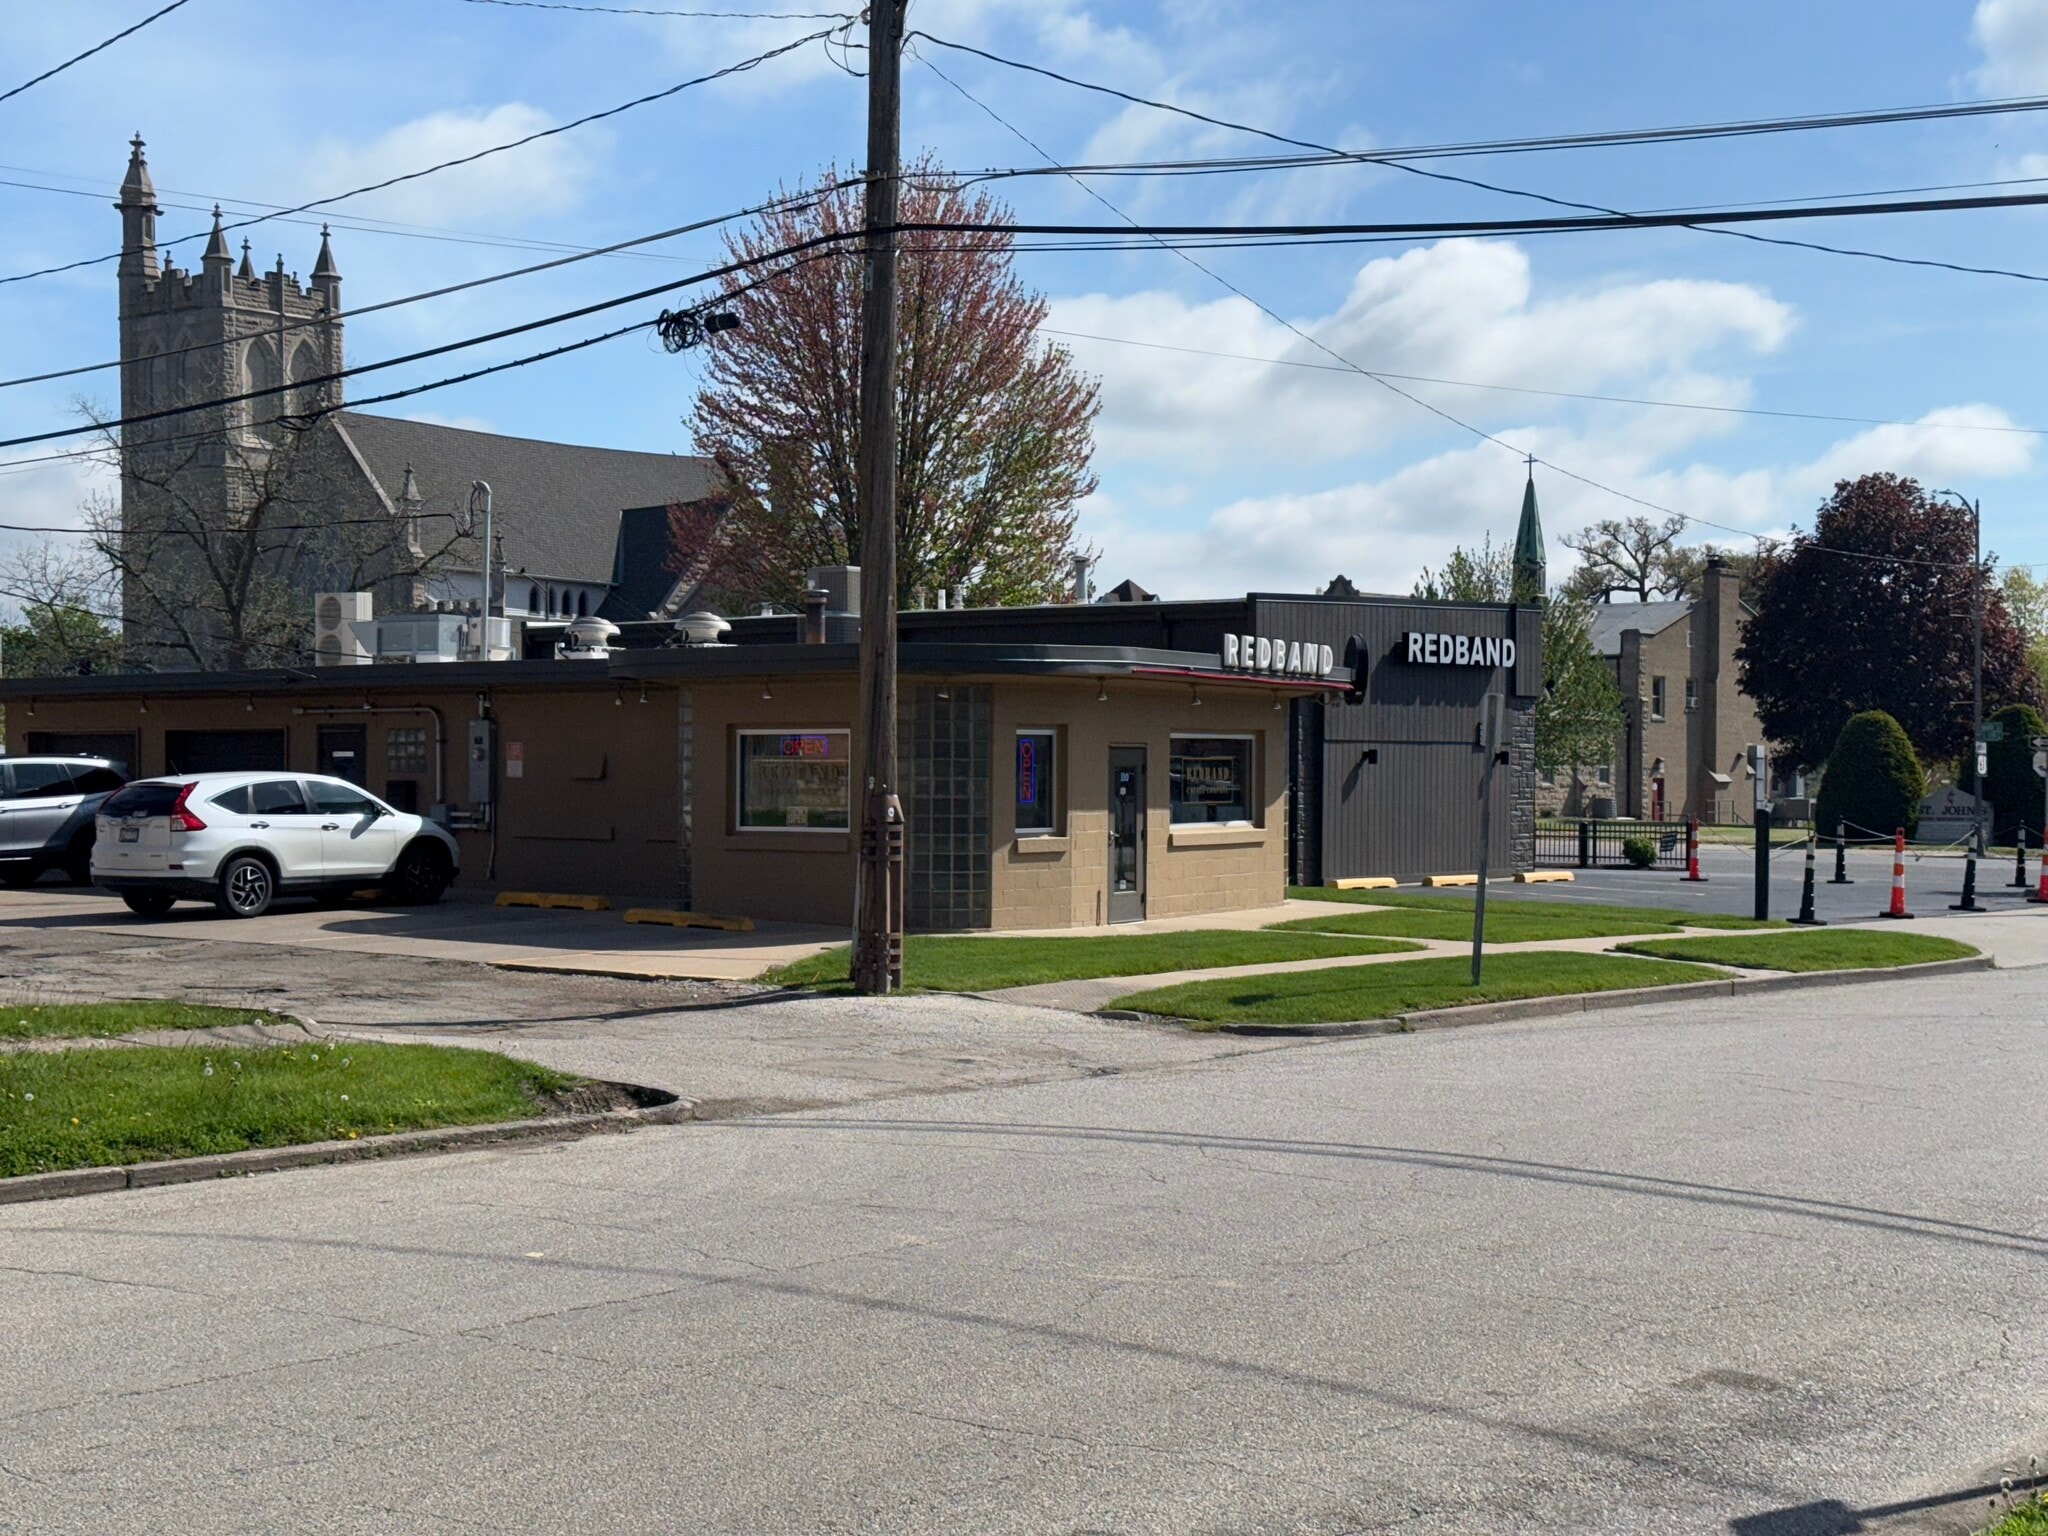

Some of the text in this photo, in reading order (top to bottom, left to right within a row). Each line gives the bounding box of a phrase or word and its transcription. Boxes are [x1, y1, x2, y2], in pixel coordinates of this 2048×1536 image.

[1223, 633, 1334, 675] REDBAND
[1408, 632, 1516, 668] REDBAND
[784, 740, 825, 755] OPEN
[1023, 743, 1032, 800] OPEN
[1187, 767, 1230, 780] REDBAND
[1942, 805, 1988, 815] JOHNS
